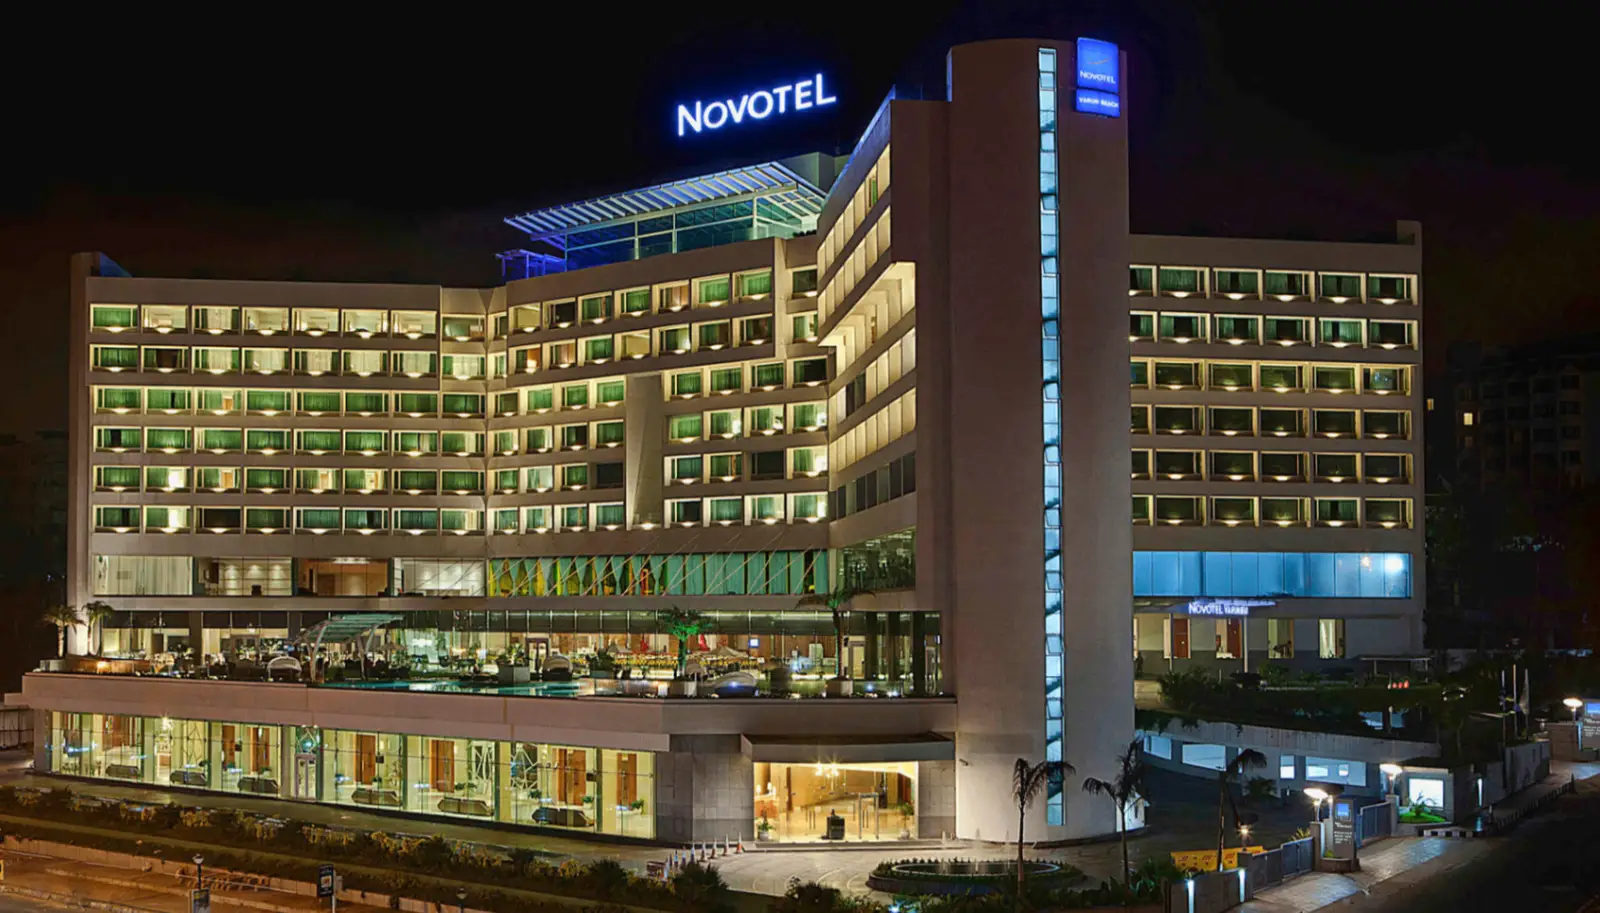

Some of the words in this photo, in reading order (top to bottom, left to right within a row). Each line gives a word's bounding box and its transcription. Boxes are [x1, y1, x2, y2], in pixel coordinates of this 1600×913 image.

[1079, 71, 1116, 84] NOVOTEL
[677, 72, 837, 137] NOVOTEL
[1189, 603, 1223, 615] NOVOTEL
